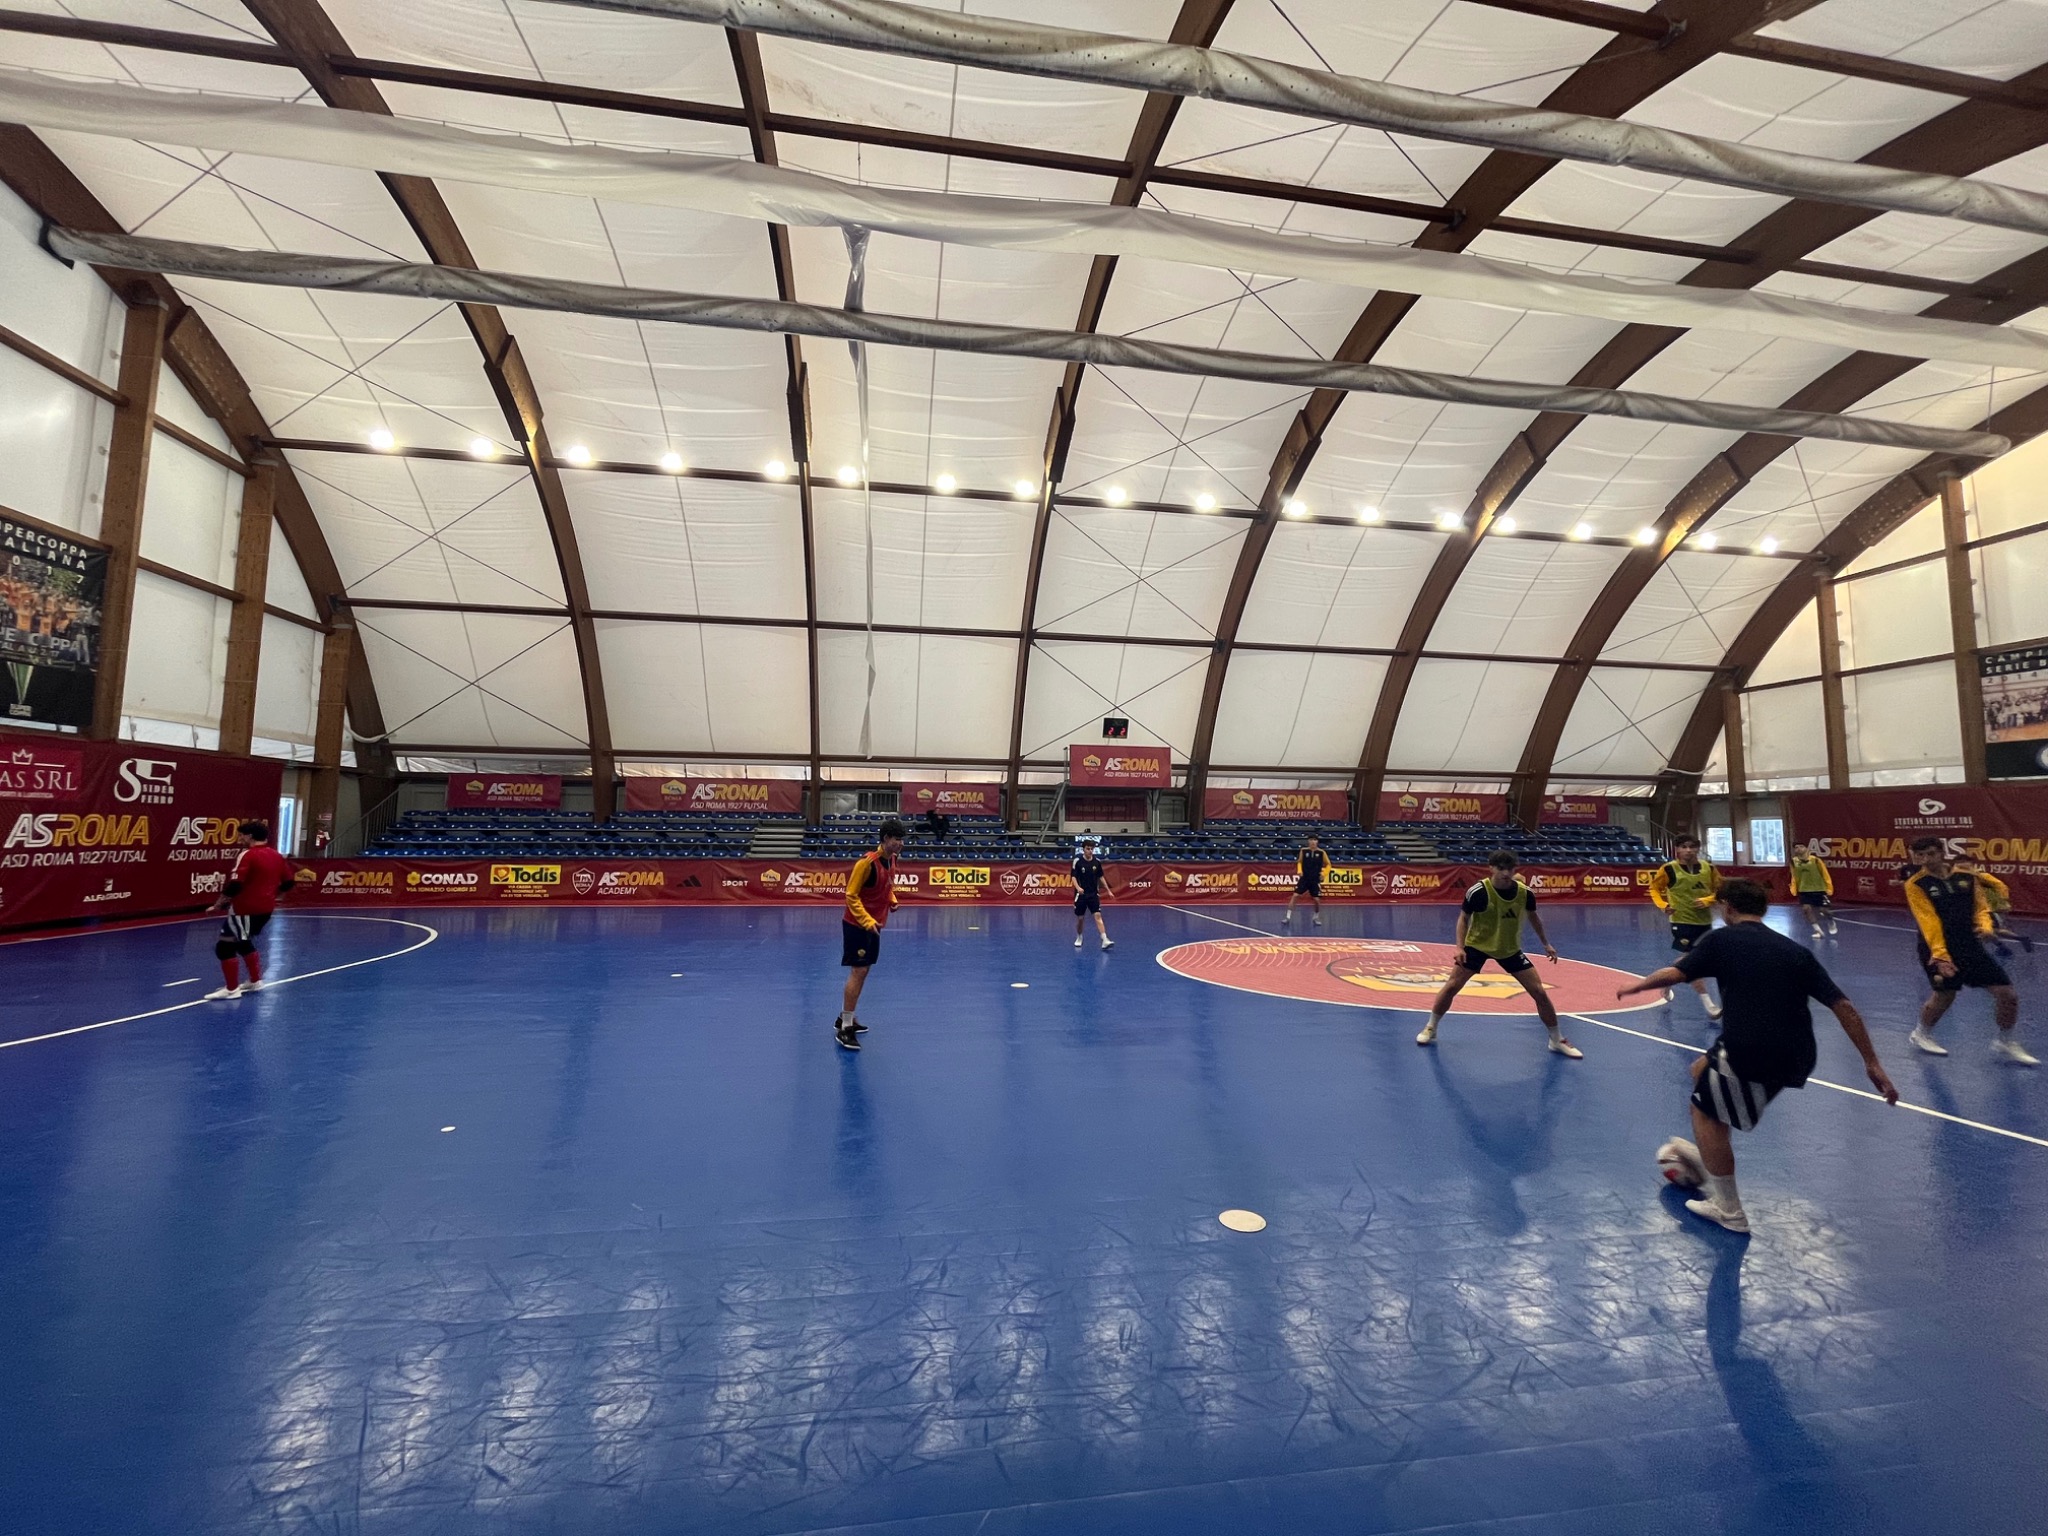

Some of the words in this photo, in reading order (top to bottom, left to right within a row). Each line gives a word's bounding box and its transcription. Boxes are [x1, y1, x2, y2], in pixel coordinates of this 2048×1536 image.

[0, 521, 87, 560] PERCOPPA
[1985, 648, 2048, 665] CAMPI
[1986, 661, 2030, 675] SERIE
[33, 770, 78, 791] SRL
[142, 784, 175, 794] SIDER
[141, 794, 174, 805] FERRO
[690, 802, 704, 810] ASD
[705, 802, 726, 810] ROMA
[728, 802, 742, 810] 1927
[743, 802, 768, 810] FUTSAL
[4, 813, 149, 848] ASROMA
[170, 817, 268, 845] ASRO
[168, 850, 188, 861] ASD
[190, 849, 217, 861] ROMA
[220, 848, 240, 860] 1927
[1808, 838, 1908, 859] ASROMA
[1939, 837, 2048, 862] SROM
[1, 854, 29, 868] ASD
[32, 852, 75, 867] ROMA
[78, 851, 107, 864] 1927
[107, 850, 148, 863] FUTSAL
[1826, 860, 1848, 868] OMA
[1849, 860, 1870, 869] 1927
[1872, 861, 1908, 870] FUTSA
[511, 867, 557, 883] Todis
[1990, 864, 2016, 874] 1927
[421, 873, 479, 885] CONAD
[598, 872, 664, 886] ASROMA
[784, 872, 847, 886] ASROMA
[894, 874, 919, 885] NAD
[947, 869, 987, 883] Todis
[1023, 874, 1074, 887] ASROM
[1186, 874, 1238, 887] ASROMA
[1259, 875, 1300, 885] CONAD
[1391, 875, 1440, 887] ASROMA
[1530, 875, 1576, 887] ASROMA
[1593, 876, 1629, 885] CONAD
[597, 887, 637, 895] ACADEMY
